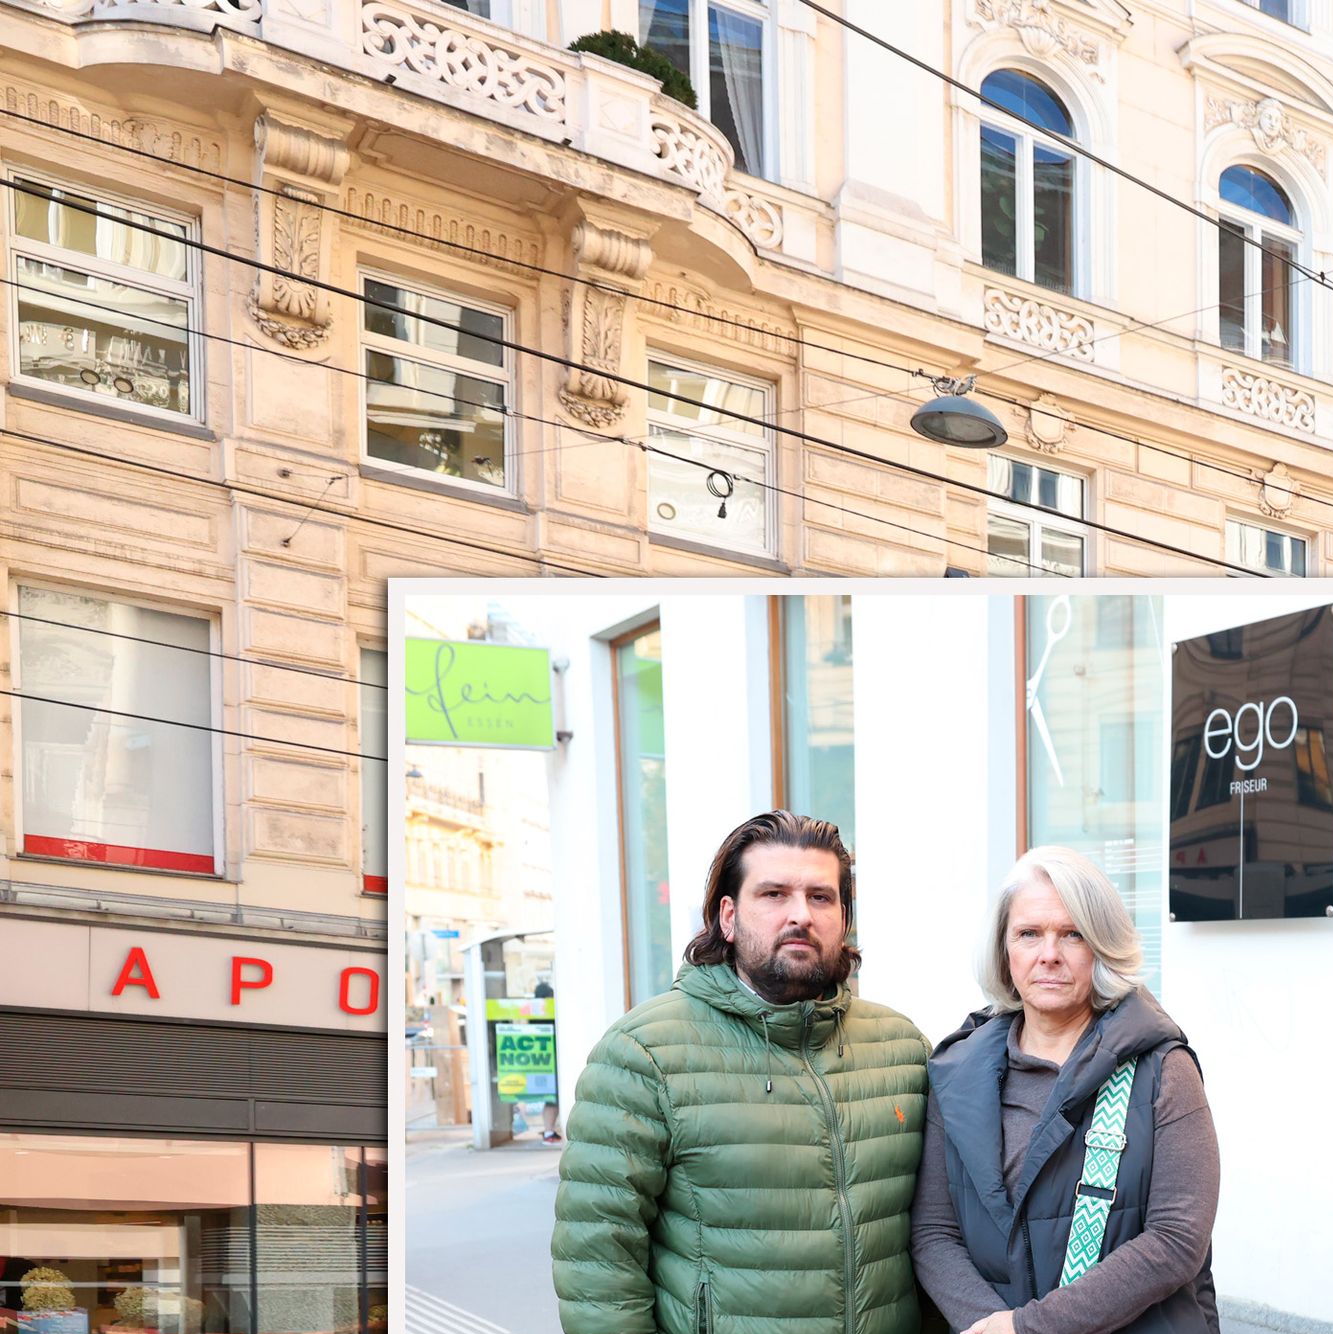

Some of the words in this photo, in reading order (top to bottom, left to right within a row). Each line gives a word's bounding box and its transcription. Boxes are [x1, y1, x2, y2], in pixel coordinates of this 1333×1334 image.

[1203, 696, 1298, 771] ego
[1229, 777, 1268, 795] FRISEUR
[111, 947, 380, 1016] APO
[500, 1035, 551, 1051] ACT
[499, 1052, 551, 1066] NOW
